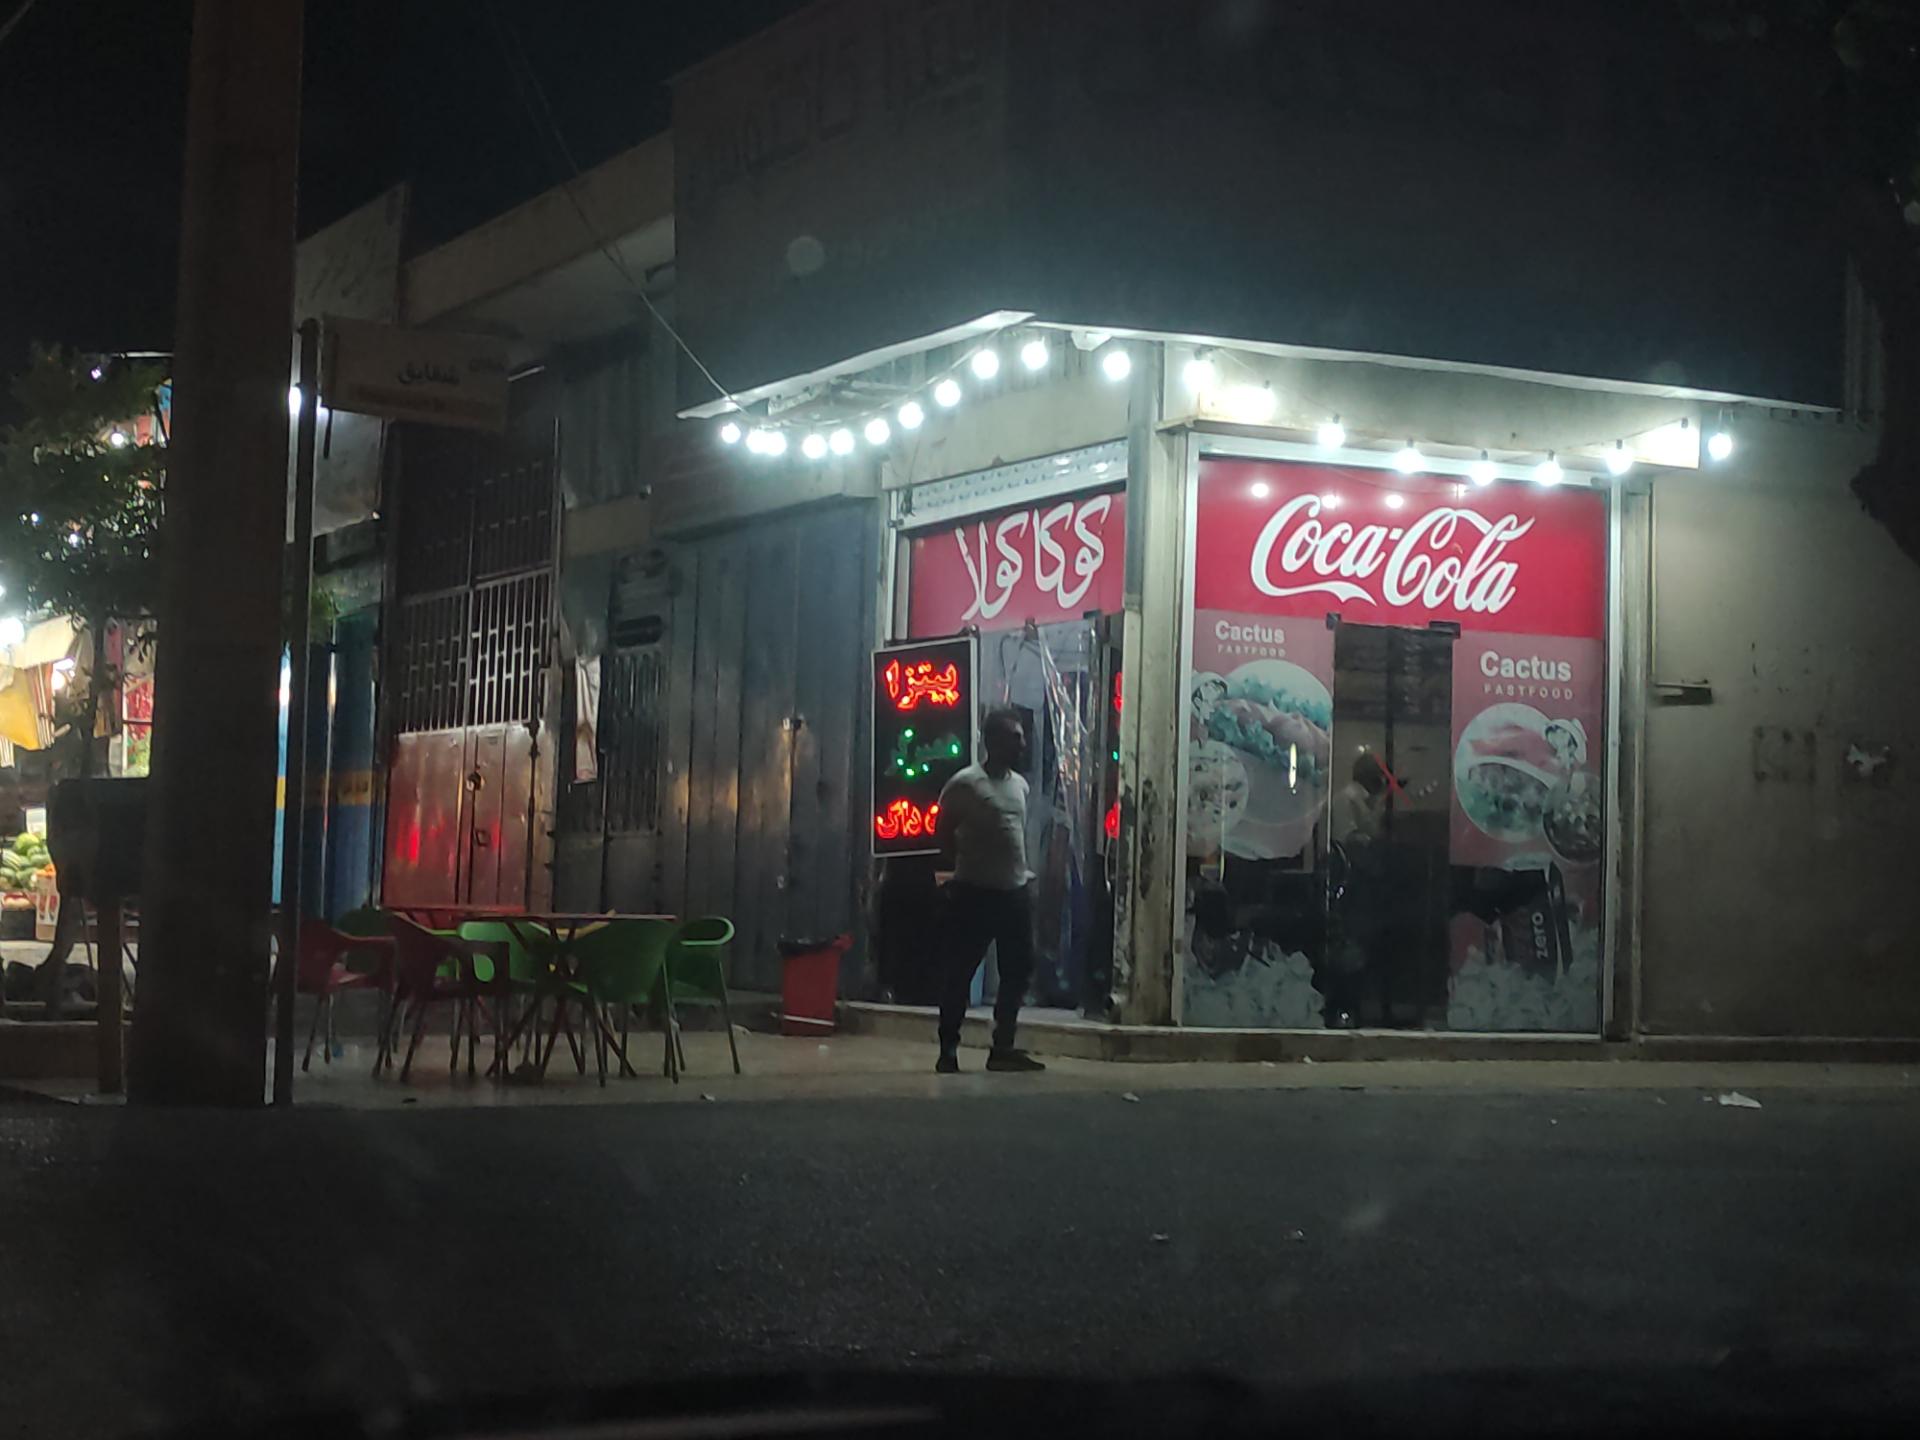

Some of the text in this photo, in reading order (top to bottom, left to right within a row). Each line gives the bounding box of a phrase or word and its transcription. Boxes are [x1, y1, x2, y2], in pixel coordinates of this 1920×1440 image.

[1250, 493, 1536, 614] Coca-Cola
[1215, 619, 1285, 644] Cactus
[884, 658, 960, 709] پیتزا
[1480, 650, 1572, 682] Cactus
[1530, 910, 1549, 960] zero
